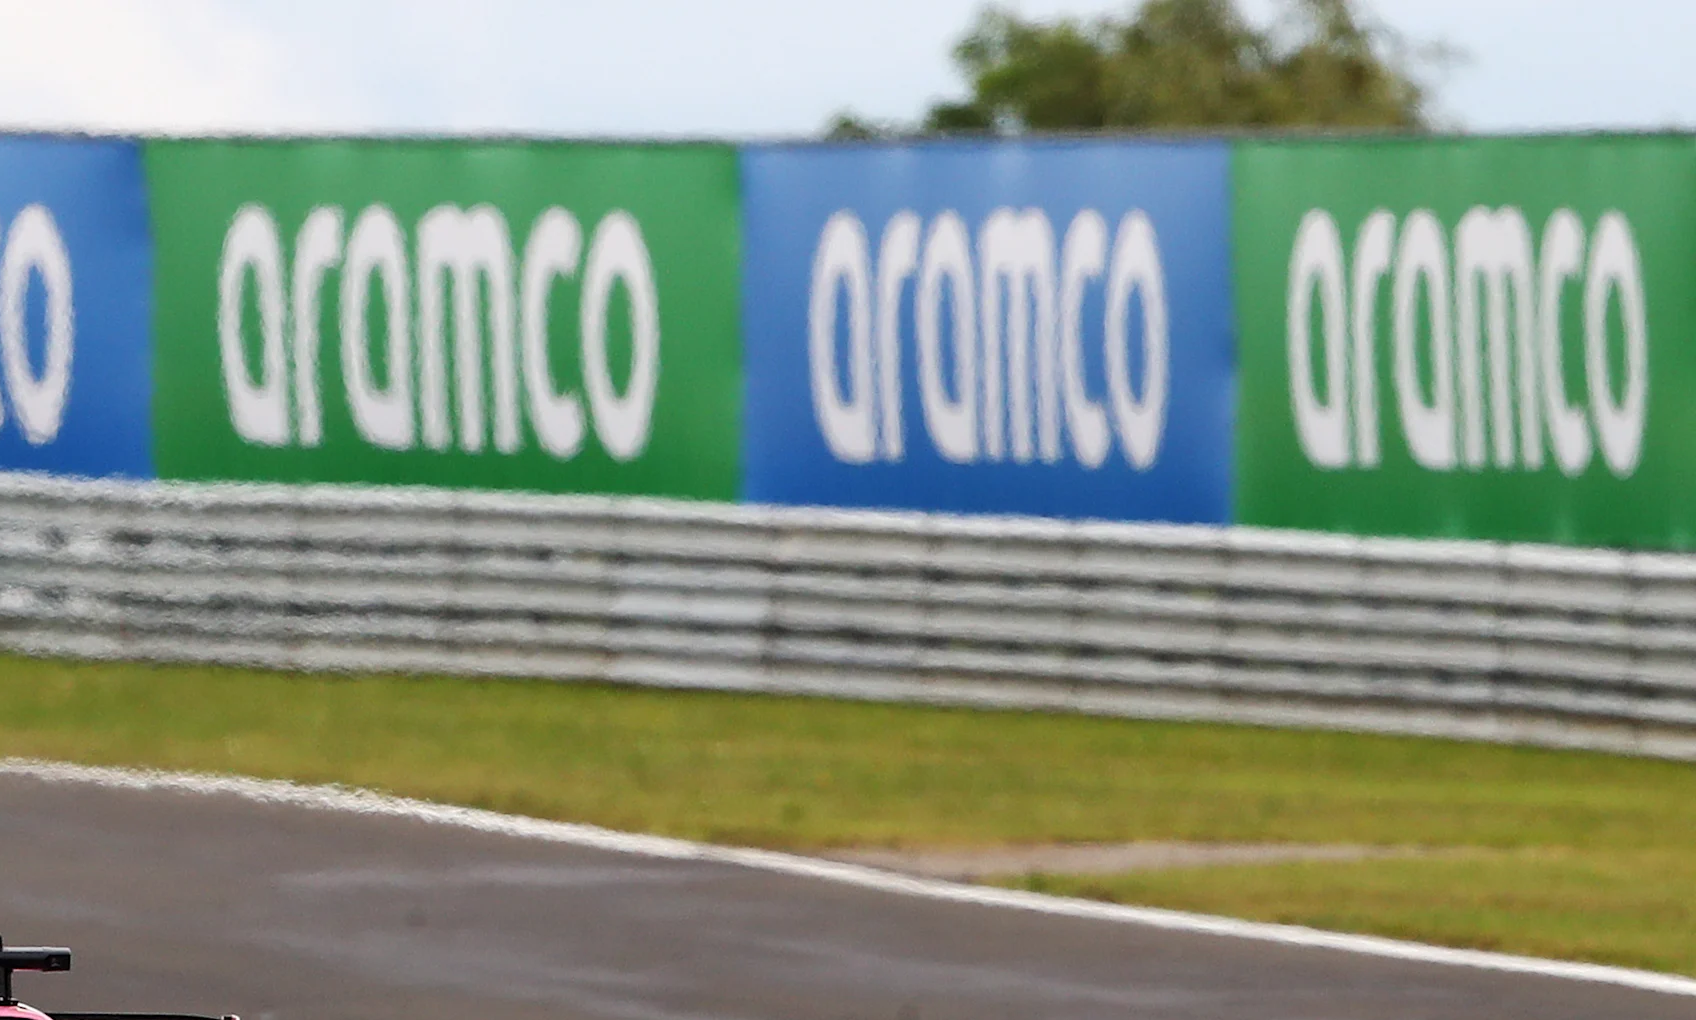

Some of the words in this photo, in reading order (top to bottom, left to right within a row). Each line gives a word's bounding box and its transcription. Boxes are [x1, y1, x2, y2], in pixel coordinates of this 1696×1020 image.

[218, 202, 660, 459] aramco
[809, 206, 1168, 468] aramco
[1287, 204, 1648, 474] aramco
